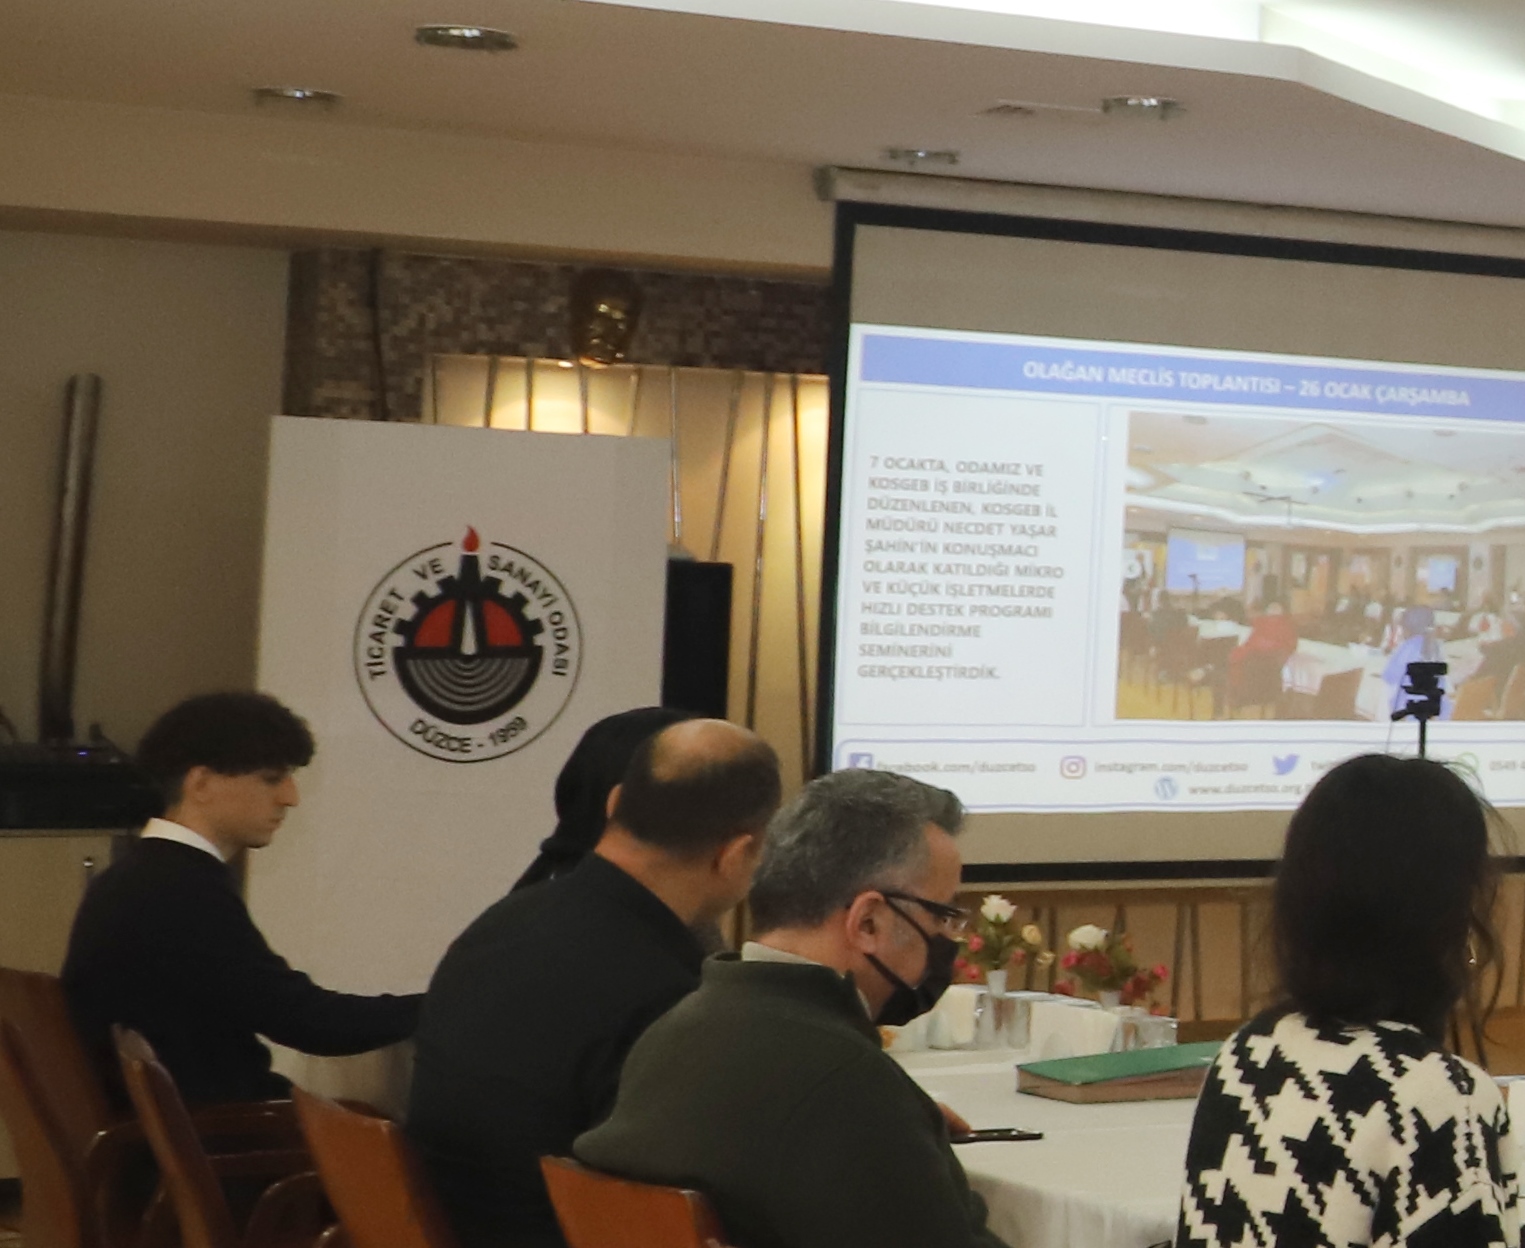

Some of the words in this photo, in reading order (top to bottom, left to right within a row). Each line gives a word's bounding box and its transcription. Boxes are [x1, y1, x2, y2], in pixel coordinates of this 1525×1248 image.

[1023, 361, 1103, 382] OLAĞAN
[1108, 366, 1174, 387] MECLİS
[1180, 371, 1280, 393] TOPLANTISI
[1300, 380, 1320, 396] 26
[1324, 382, 1372, 399] OCAK
[1376, 386, 1470, 406] ÇARŞAMBA
[870, 455, 879, 468] 7
[956, 461, 1021, 475] ODAMIZ
[1025, 464, 1044, 477] VE
[869, 477, 929, 491] KOSGEB
[934, 478, 948, 495] İŞ
[953, 480, 1040, 496] BİRLİĞİNDE
[982, 503, 1041, 516] KOSGEB
[866, 516, 938, 532] MÜDÜRÜ
[943, 522, 1004, 535] NECDET
[1009, 524, 1057, 539] YAŞAR
[943, 542, 1038, 558] KONUŞMACI
[864, 560, 927, 574] OLARAK
[933, 562, 1009, 577] KATILDIĞI
[1014, 564, 1064, 579] MİKRO
[863, 581, 881, 593] VE
[886, 581, 941, 597] KÜÇÜK
[945, 583, 1055, 599] İŞLETMELERDE
[364, 588, 405, 680] TİCARET
[412, 557, 445, 582] VE
[488, 554, 556, 608] SANAYİ
[549, 610, 568, 677] ODASI
[861, 602, 901, 615] HIZLI
[906, 604, 964, 616] DESTEK
[969, 605, 1053, 618] PROGRAMI
[860, 621, 980, 637] BİLGİLENDİRME
[859, 643, 953, 657] SEMİNERİNİ
[409, 717, 472, 754] DÜZCE
